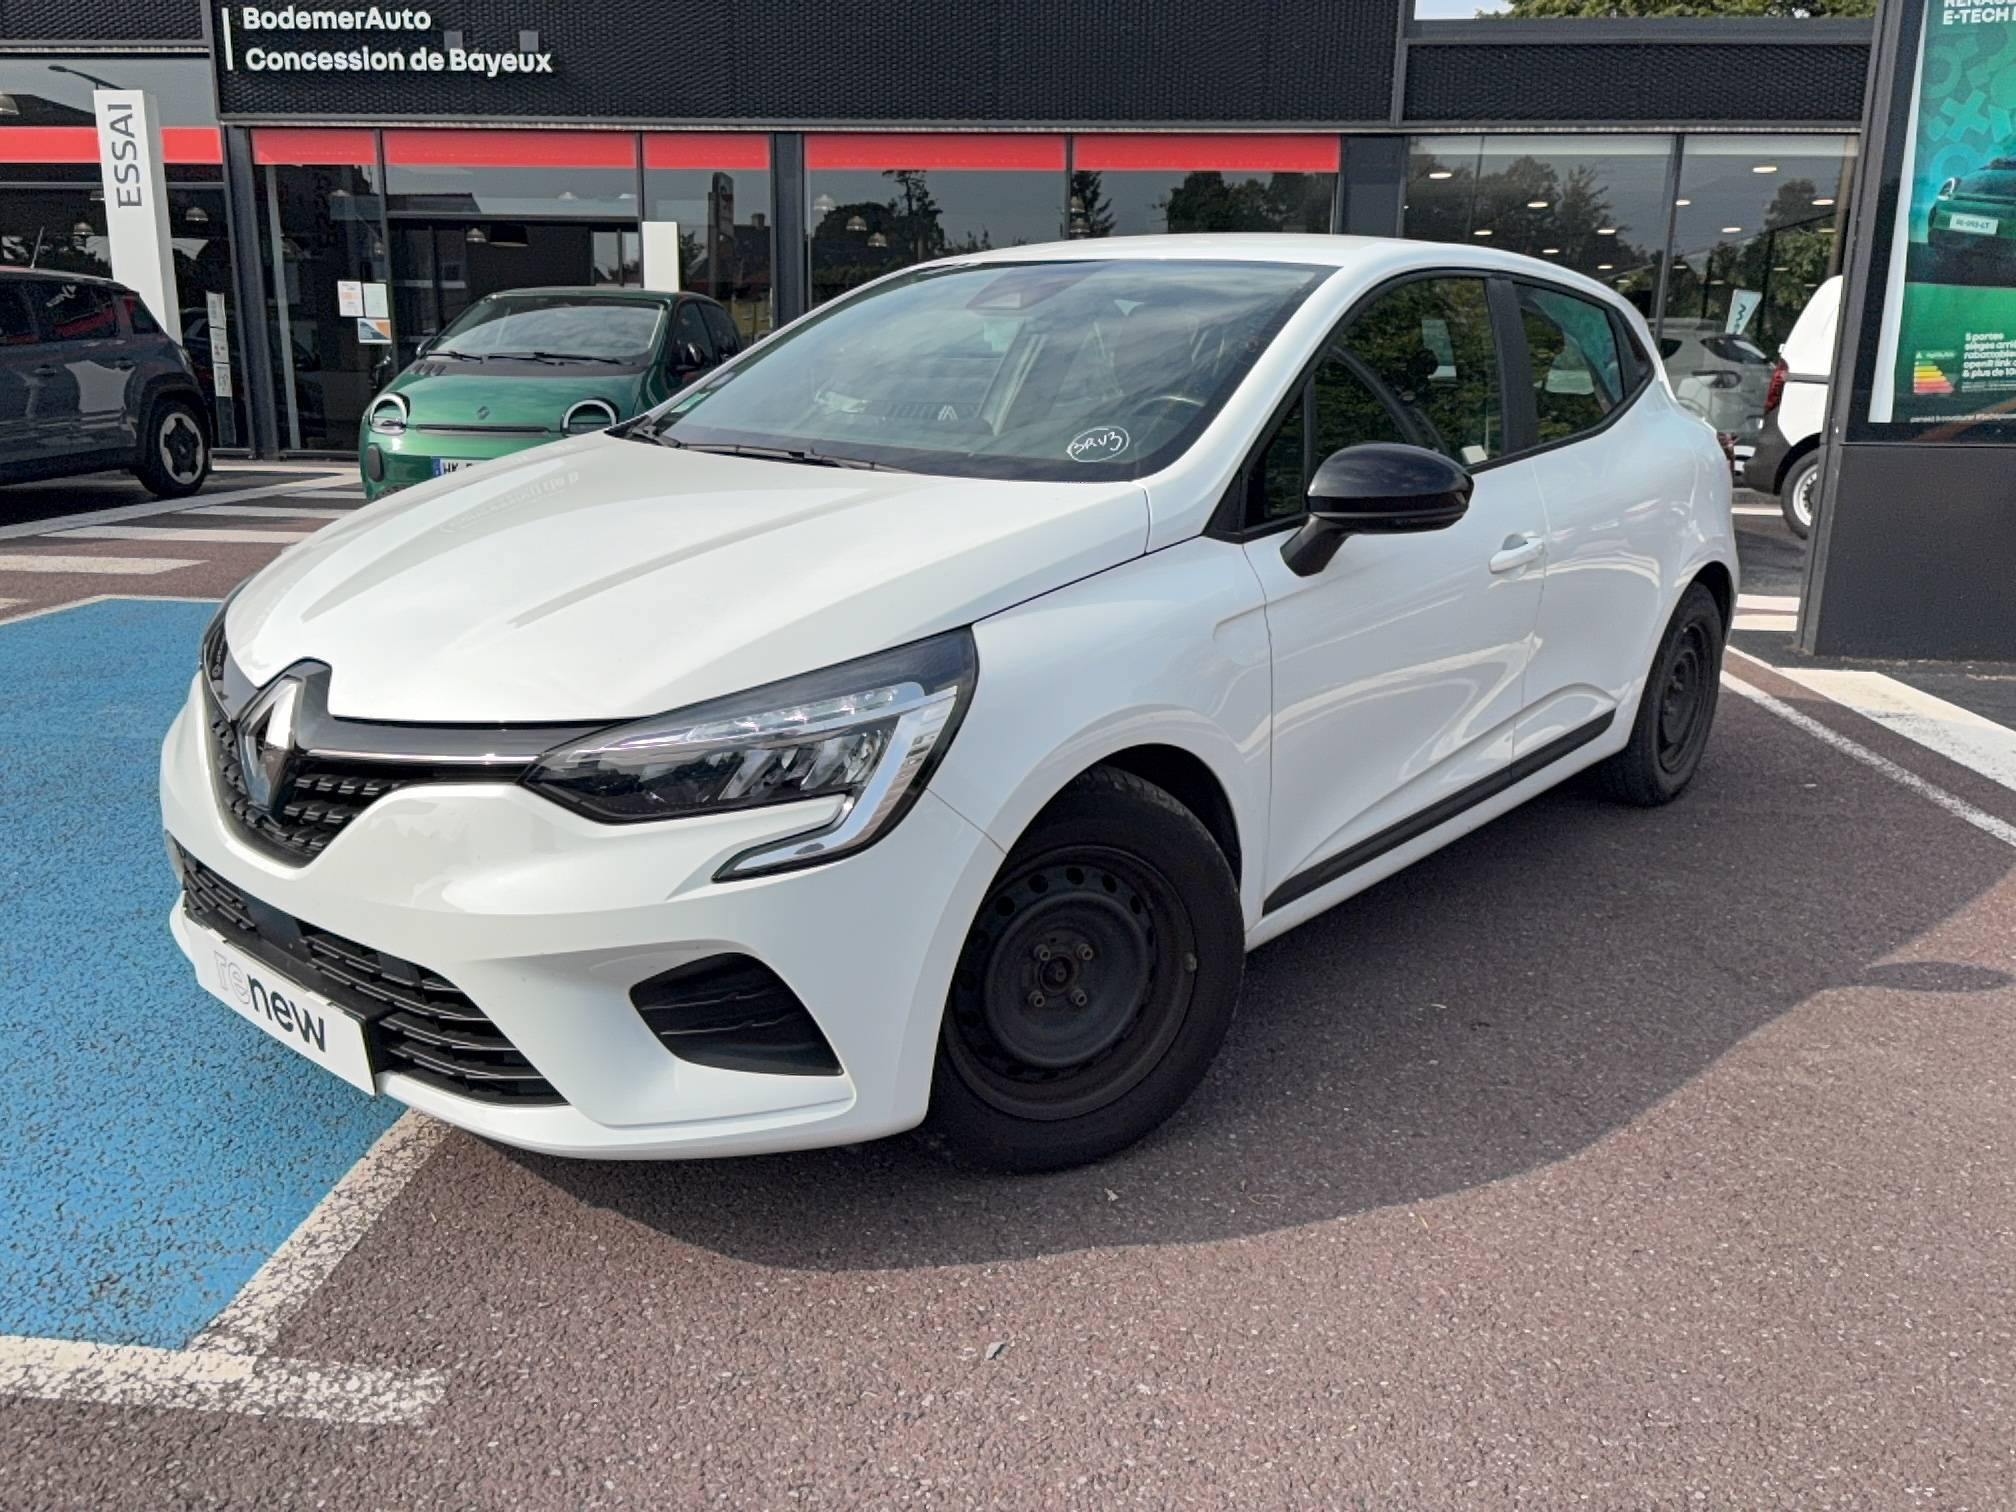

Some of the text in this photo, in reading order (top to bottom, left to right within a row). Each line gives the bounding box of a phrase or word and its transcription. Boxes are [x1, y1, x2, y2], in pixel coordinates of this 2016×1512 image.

[242, 6, 431, 30] BodemerAuto
[1943, 7, 2009, 25] E-TECH
[245, 46, 553, 78] Concession de Bayeux
[107, 104, 142, 208] ESSAI
[1991, 367, 2004, 377] de
[214, 950, 325, 1053] renew
